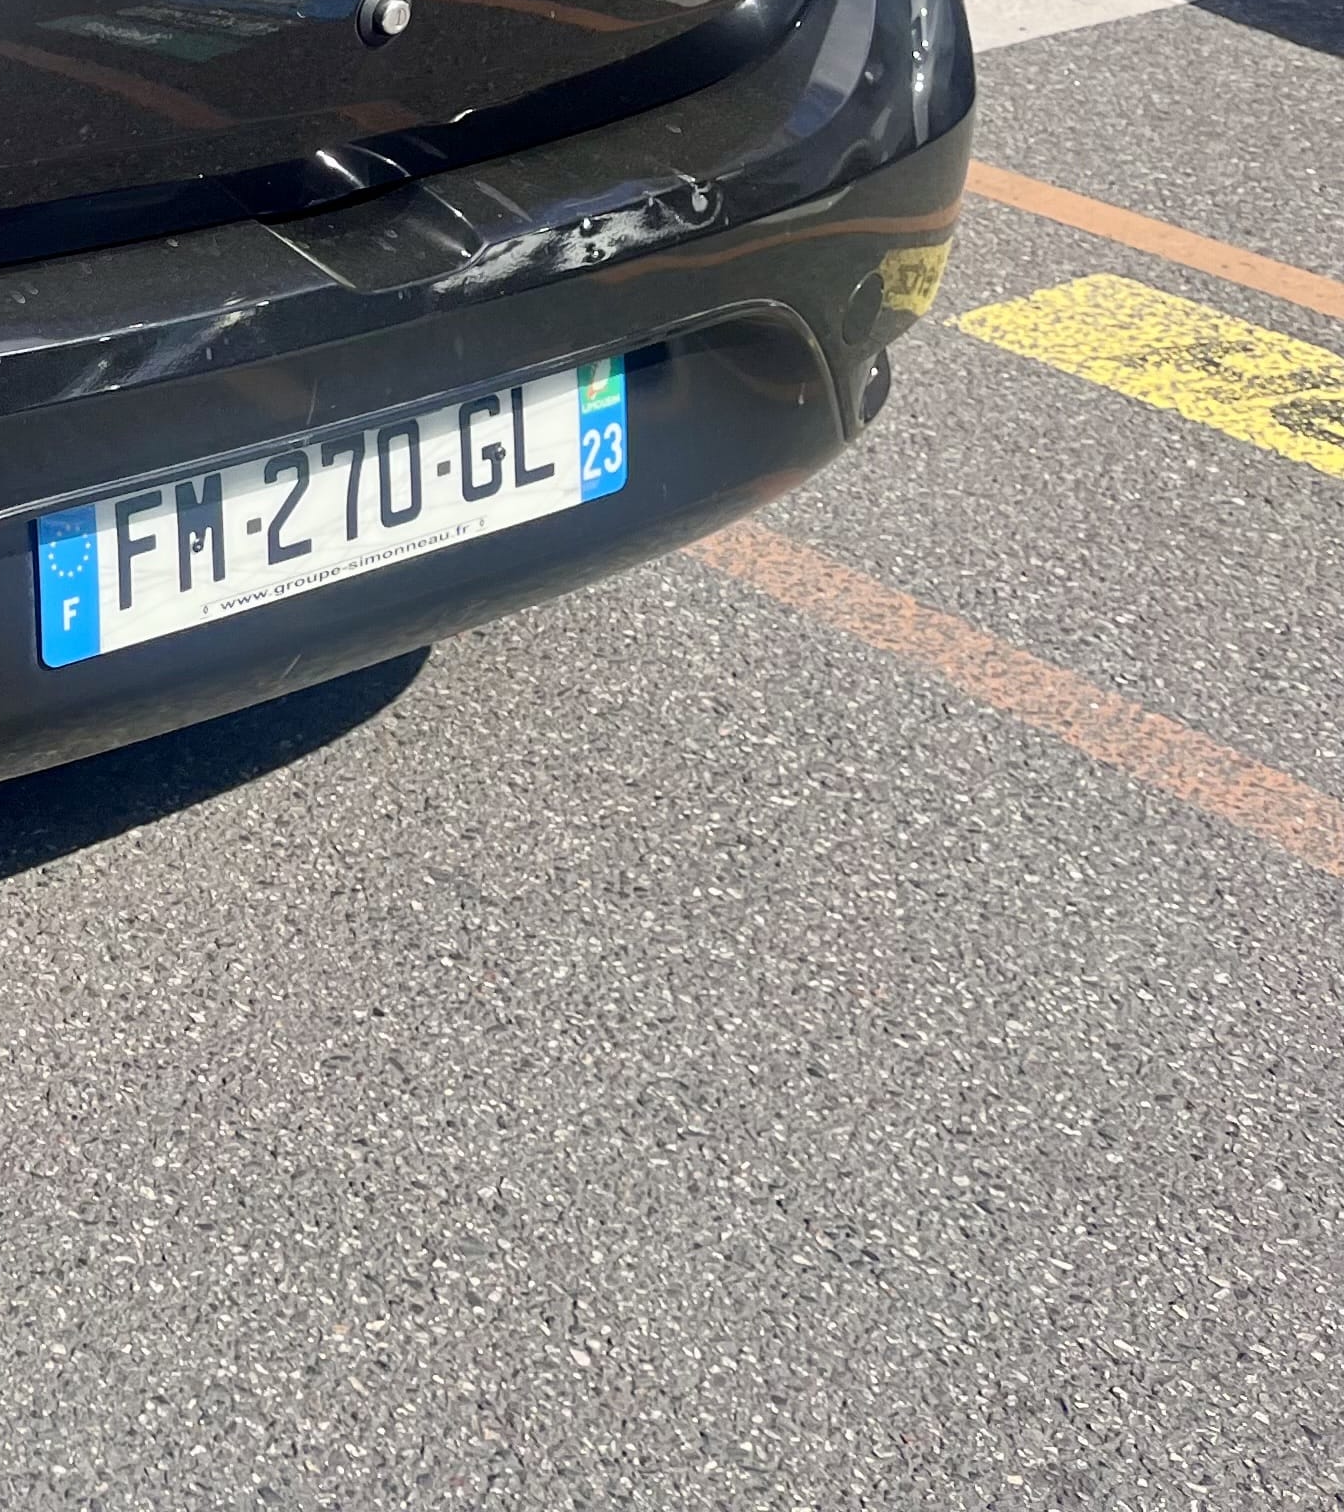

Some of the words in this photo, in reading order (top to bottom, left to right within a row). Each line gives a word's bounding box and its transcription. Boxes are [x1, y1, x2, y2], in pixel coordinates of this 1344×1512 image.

[581, 422, 623, 481] 23
[220, 522, 470, 612] www.groupe-simonneau.fr
[62, 596, 81, 632] F
